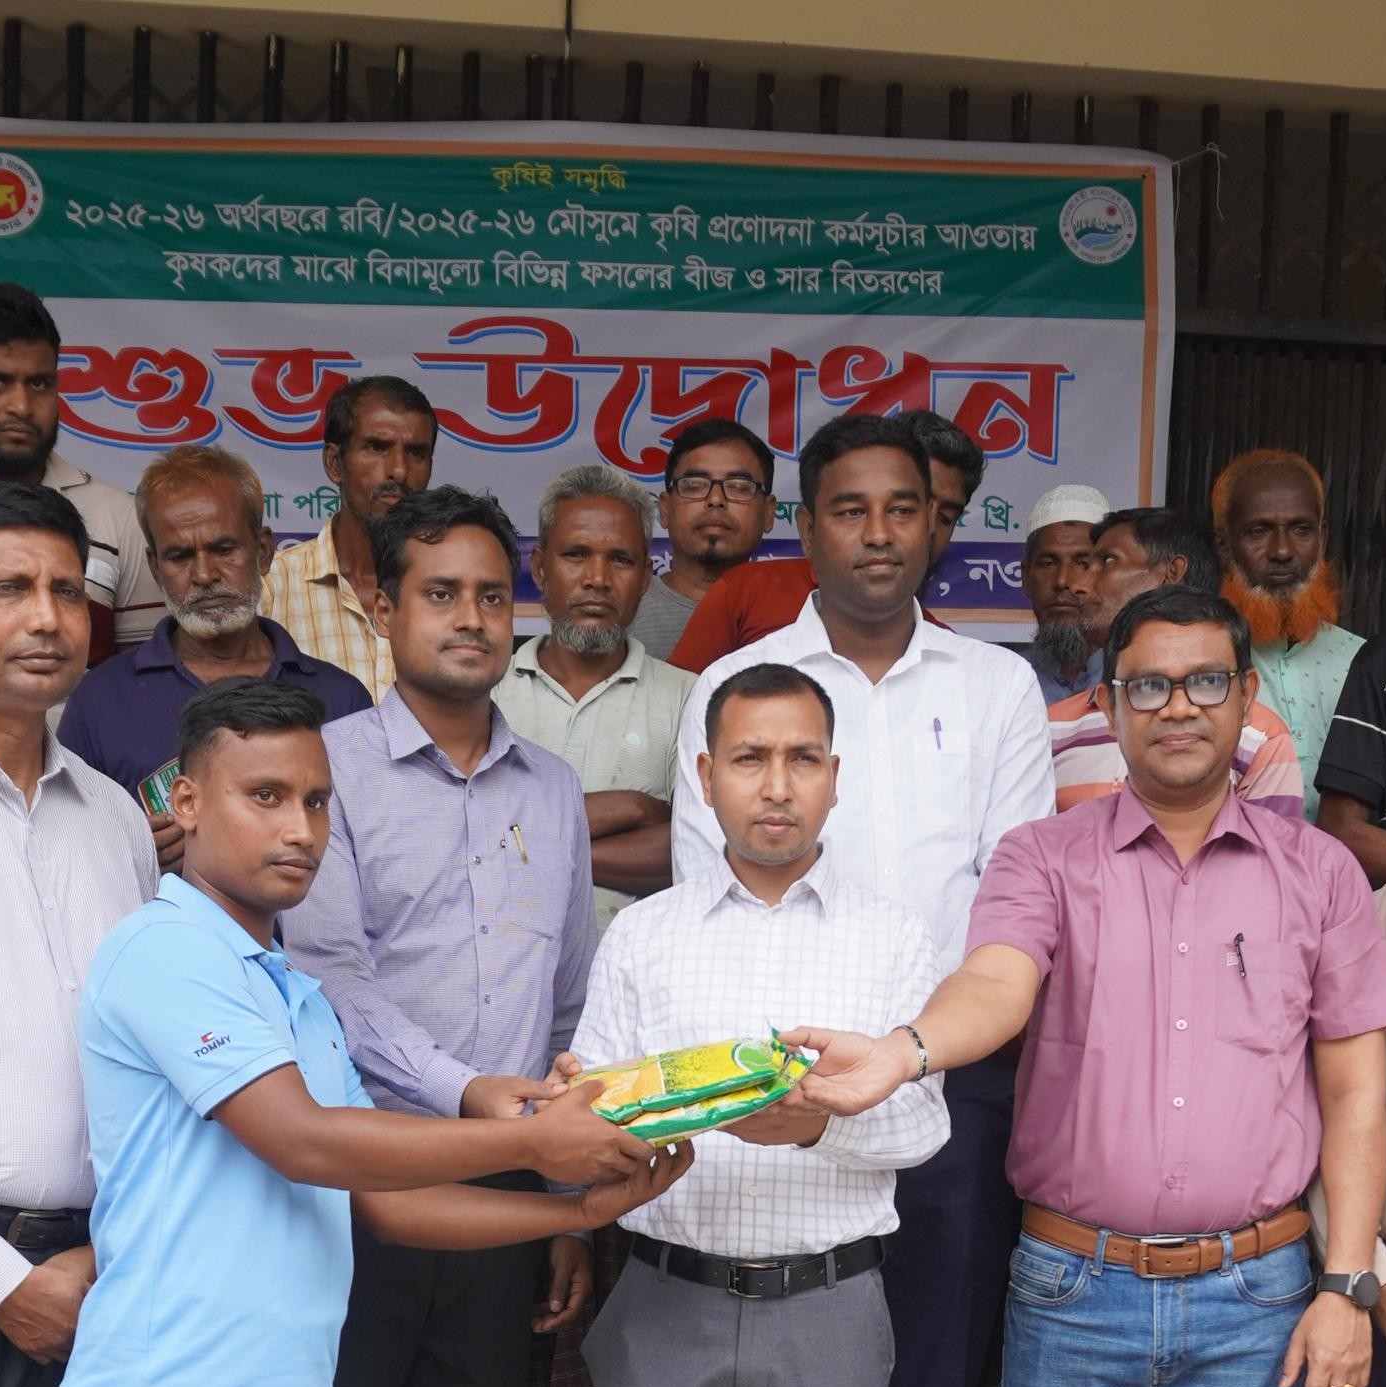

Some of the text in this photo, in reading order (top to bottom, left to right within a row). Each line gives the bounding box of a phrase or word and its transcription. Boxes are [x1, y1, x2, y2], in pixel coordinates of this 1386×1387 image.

[491, 161, 627, 196] কৃষিই সমৃদ্ধি
[66, 195, 1038, 256] ২০২৫-২৬ অর্থবছরে রবি/২০২৫-২৬ মৌসুমে কৃষি প্রণোদনা কর্মসূচীর আওতায়
[162, 248, 944, 296] কৃষকদের মাঝে বিনামূল্যে বিভিন্ন ফসলের বীজ ও সার বিতরণের
[56, 316, 1075, 482] শুভ উদ্বোধন
[193, 1034, 231, 1058] TOMMY
